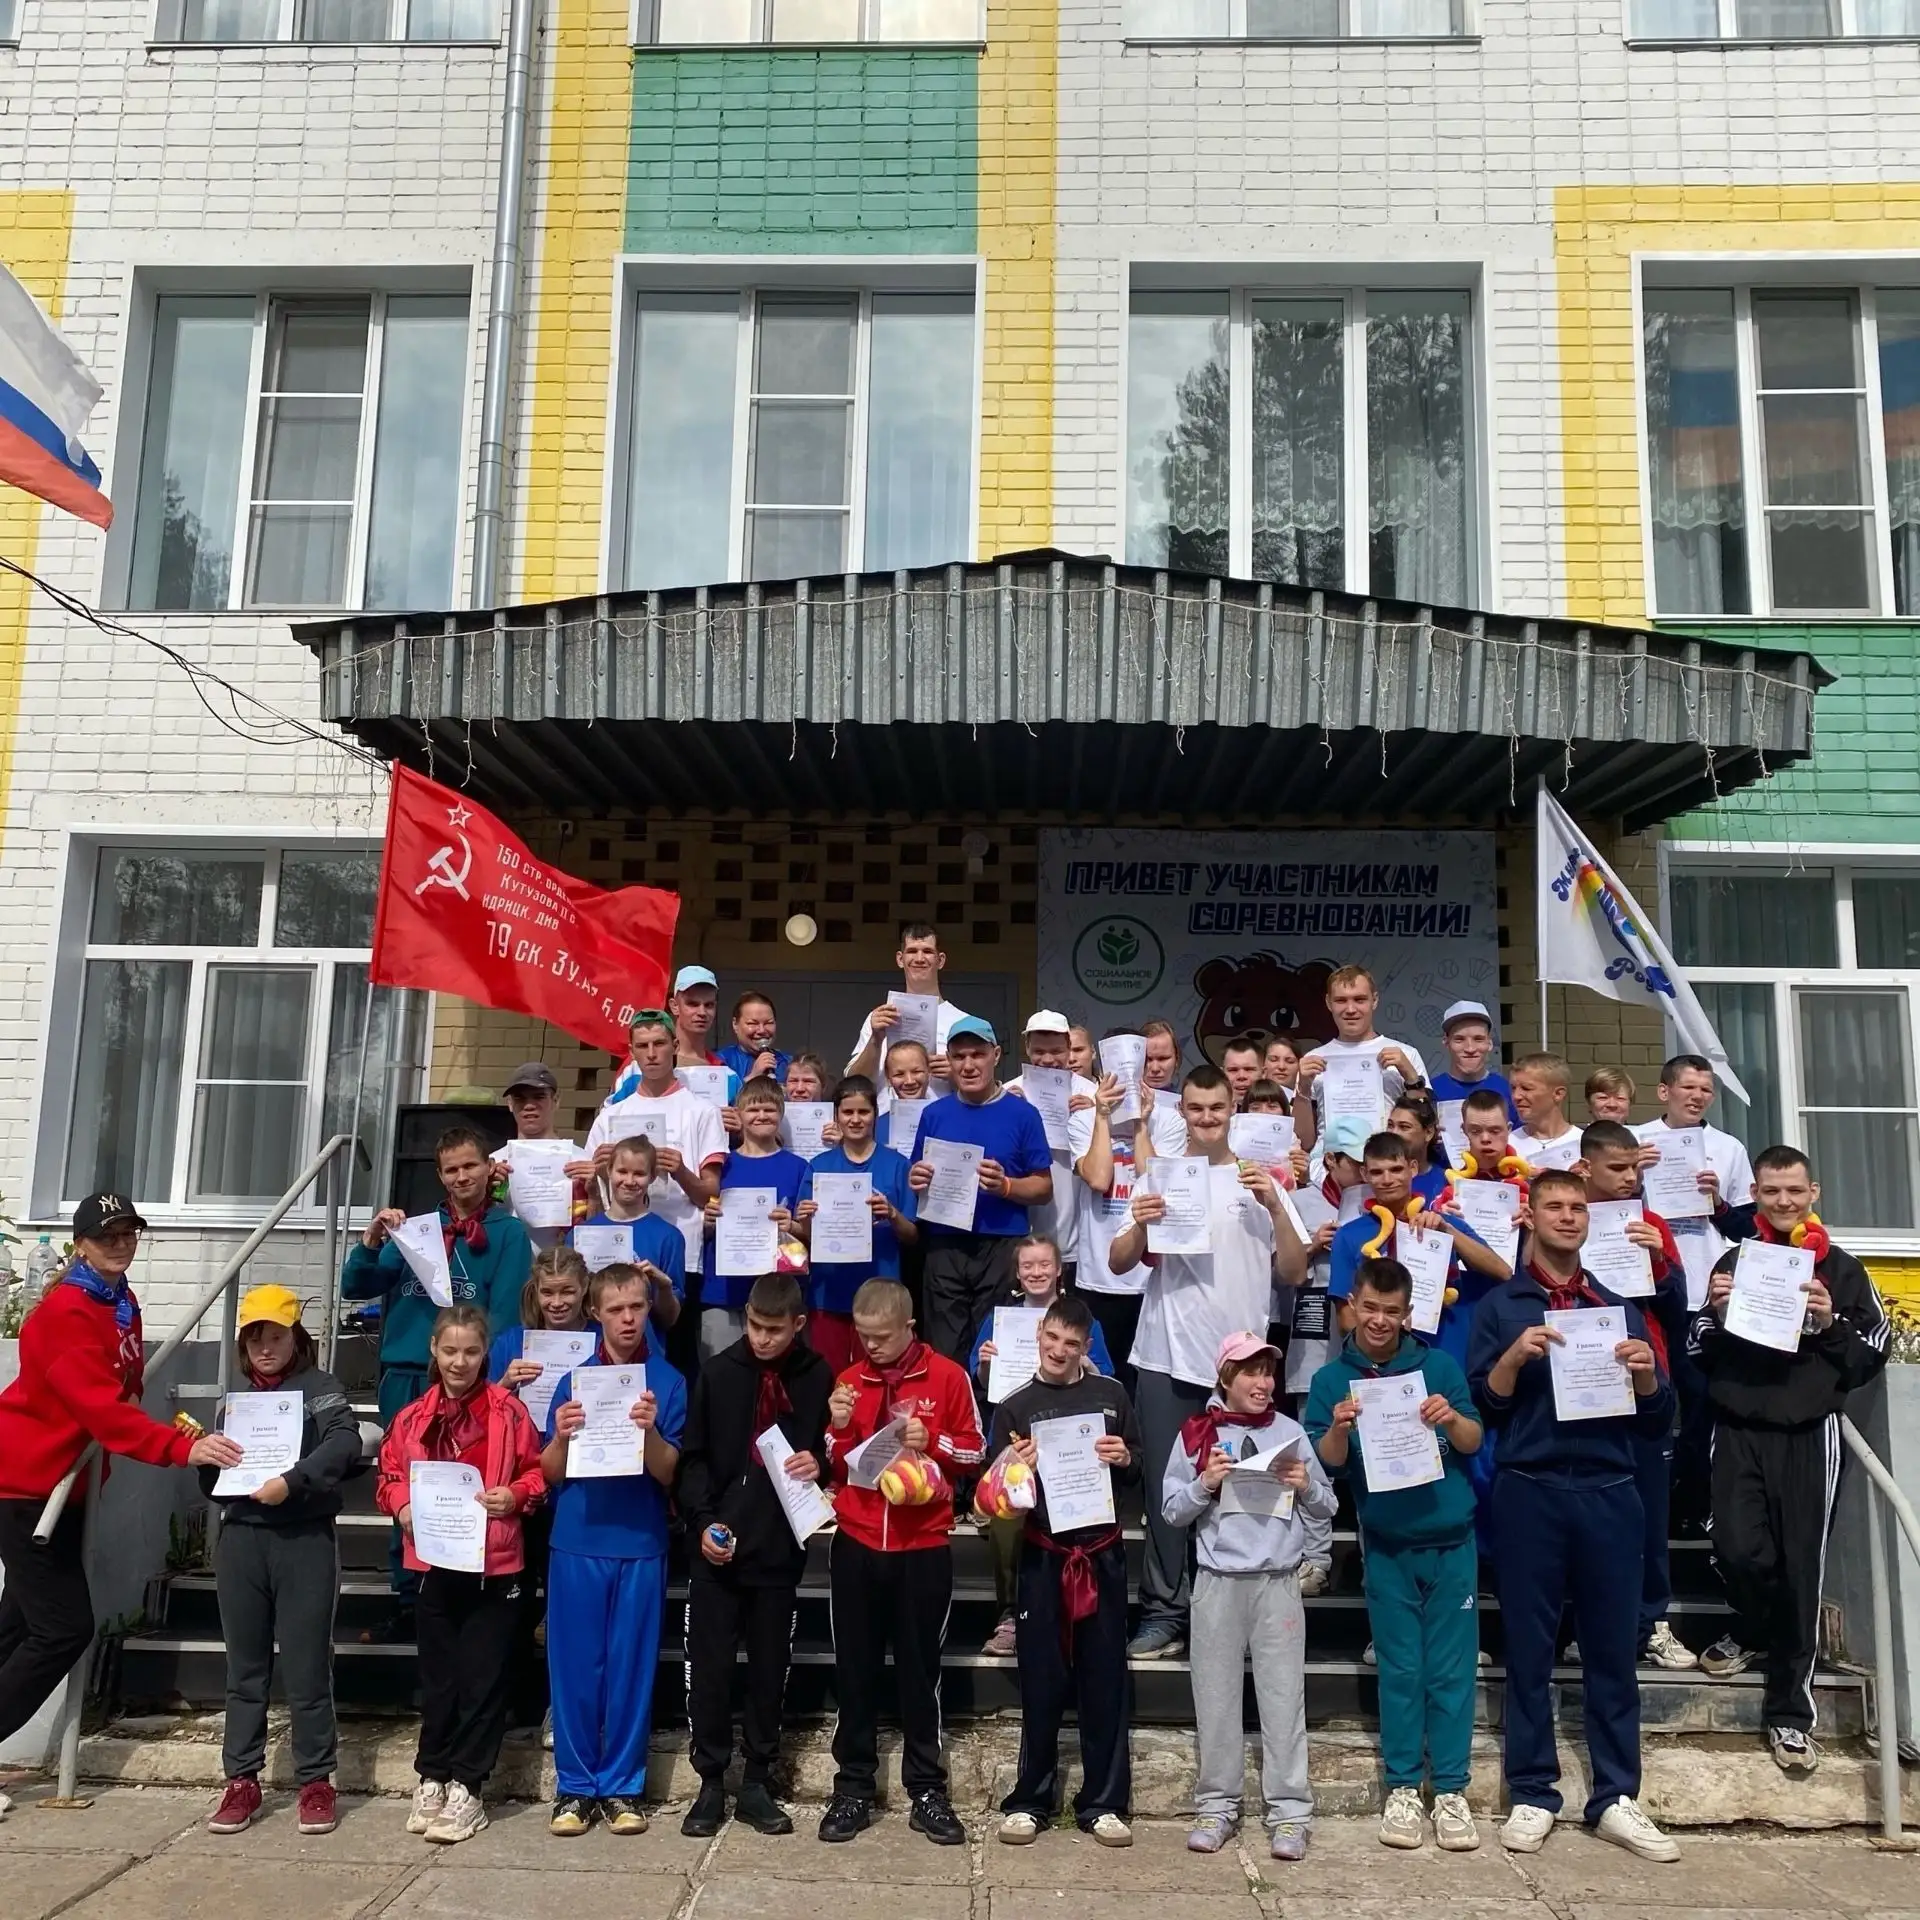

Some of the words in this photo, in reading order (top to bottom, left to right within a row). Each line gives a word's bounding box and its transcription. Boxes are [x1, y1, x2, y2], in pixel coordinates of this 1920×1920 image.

[497, 843, 520, 869] 150
[1065, 862, 1201, 895] ПРИВЕТ
[1206, 863, 1439, 897] УЧАСТНИКАМ
[1188, 901, 1471, 937] СОРЕВНОВАНИЙ!
[486, 920, 512, 959] 79
[98, 1194, 122, 1213] NY
[401, 1280, 476, 1299] adas
